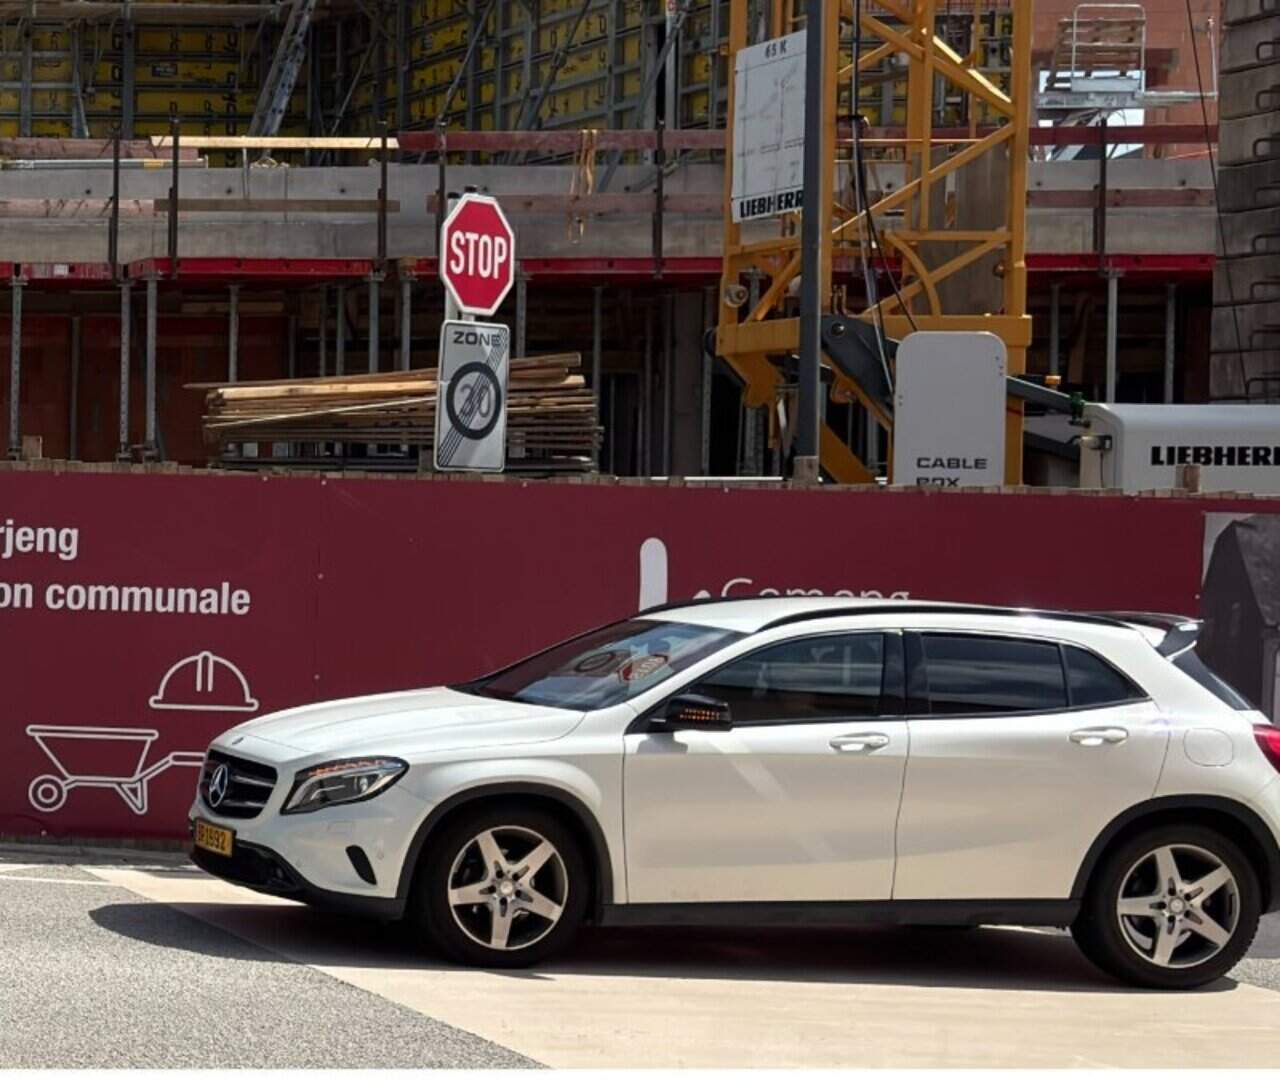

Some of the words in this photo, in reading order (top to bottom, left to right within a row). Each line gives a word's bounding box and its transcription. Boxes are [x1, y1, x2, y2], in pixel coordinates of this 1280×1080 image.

[450, 230, 508, 279] STOP
[453, 331, 502, 347] ZONE
[916, 457, 988, 470] CABLE
[45, 581, 251, 615] communale
